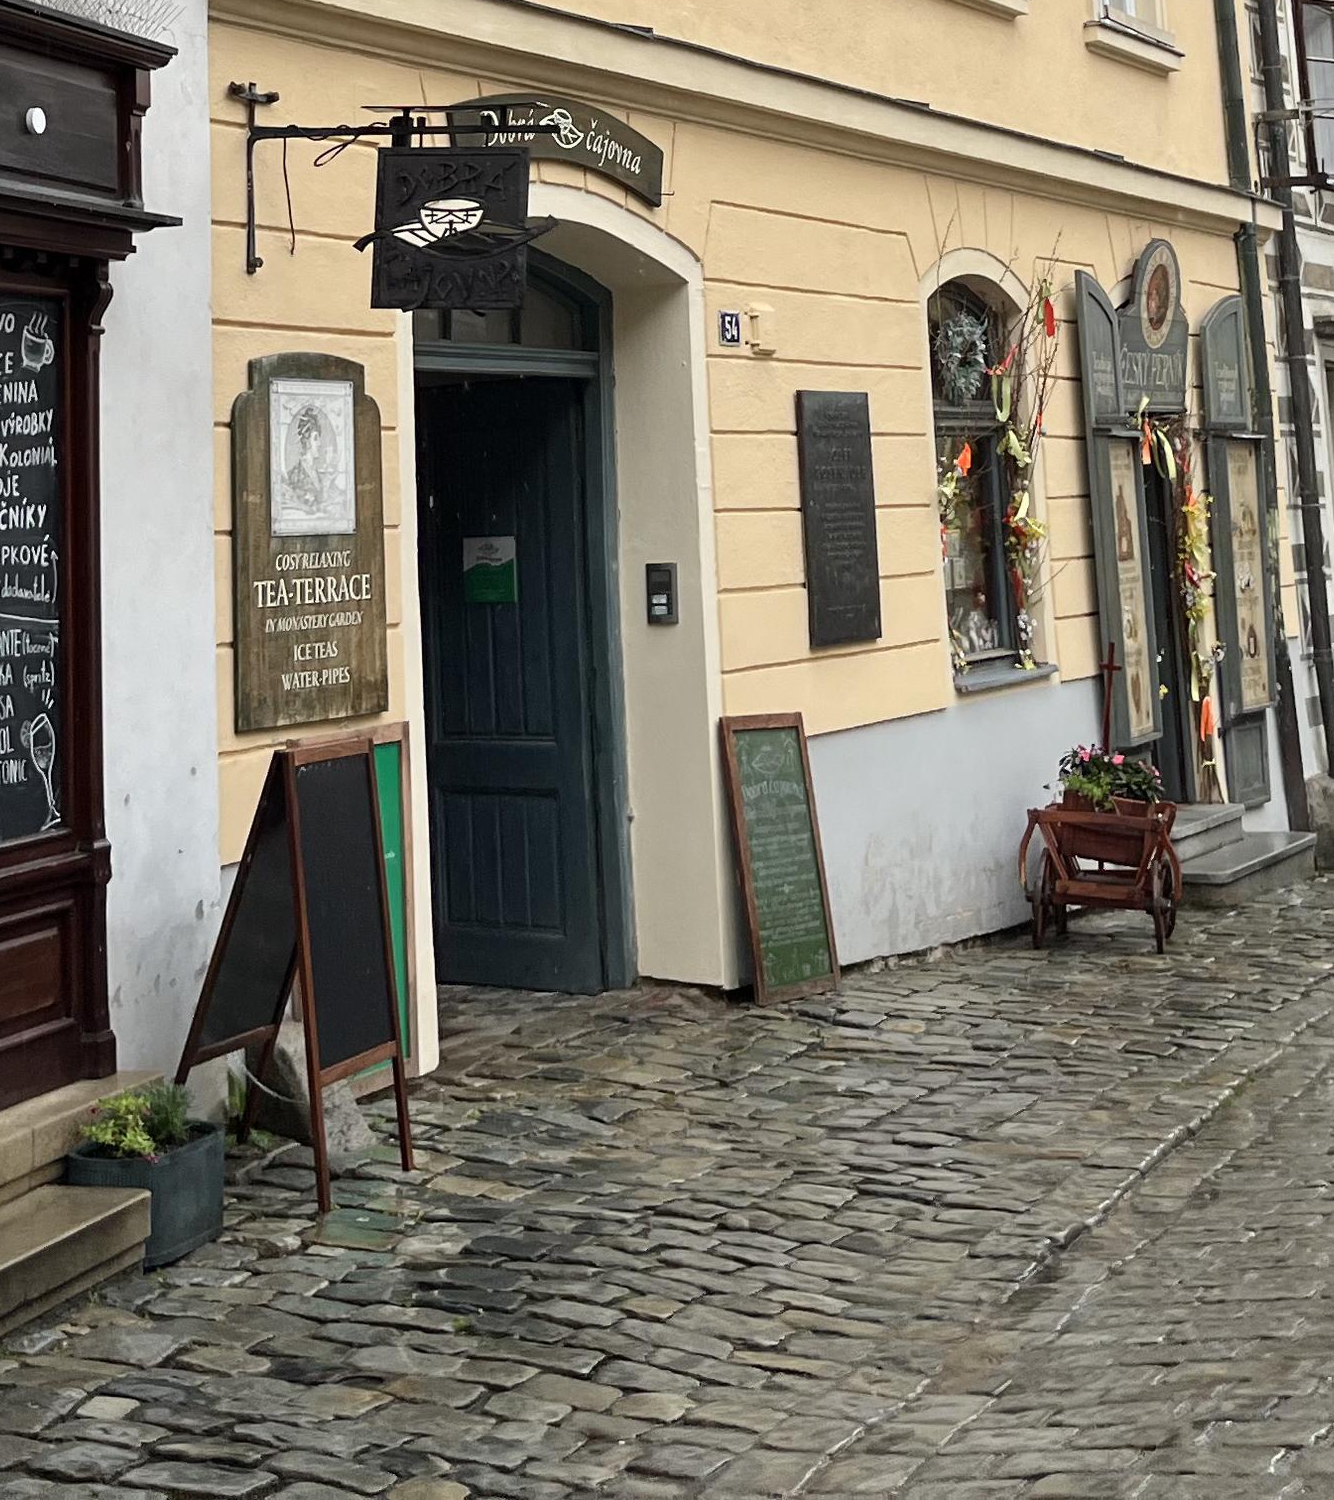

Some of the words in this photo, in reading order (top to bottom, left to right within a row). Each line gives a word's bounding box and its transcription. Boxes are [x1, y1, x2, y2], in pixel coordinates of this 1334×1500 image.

[585, 117, 641, 175] čajovna
[725, 316, 738, 340] 54
[0, 408, 53, 438] VÝROBKY
[275, 553, 302, 571] COSY
[302, 550, 351, 570] RELAXING
[276, 614, 329, 633] MONASTERY
[329, 610, 363, 628] GARDEN
[294, 643, 312, 661] ICE
[312, 641, 338, 660] TEAS
